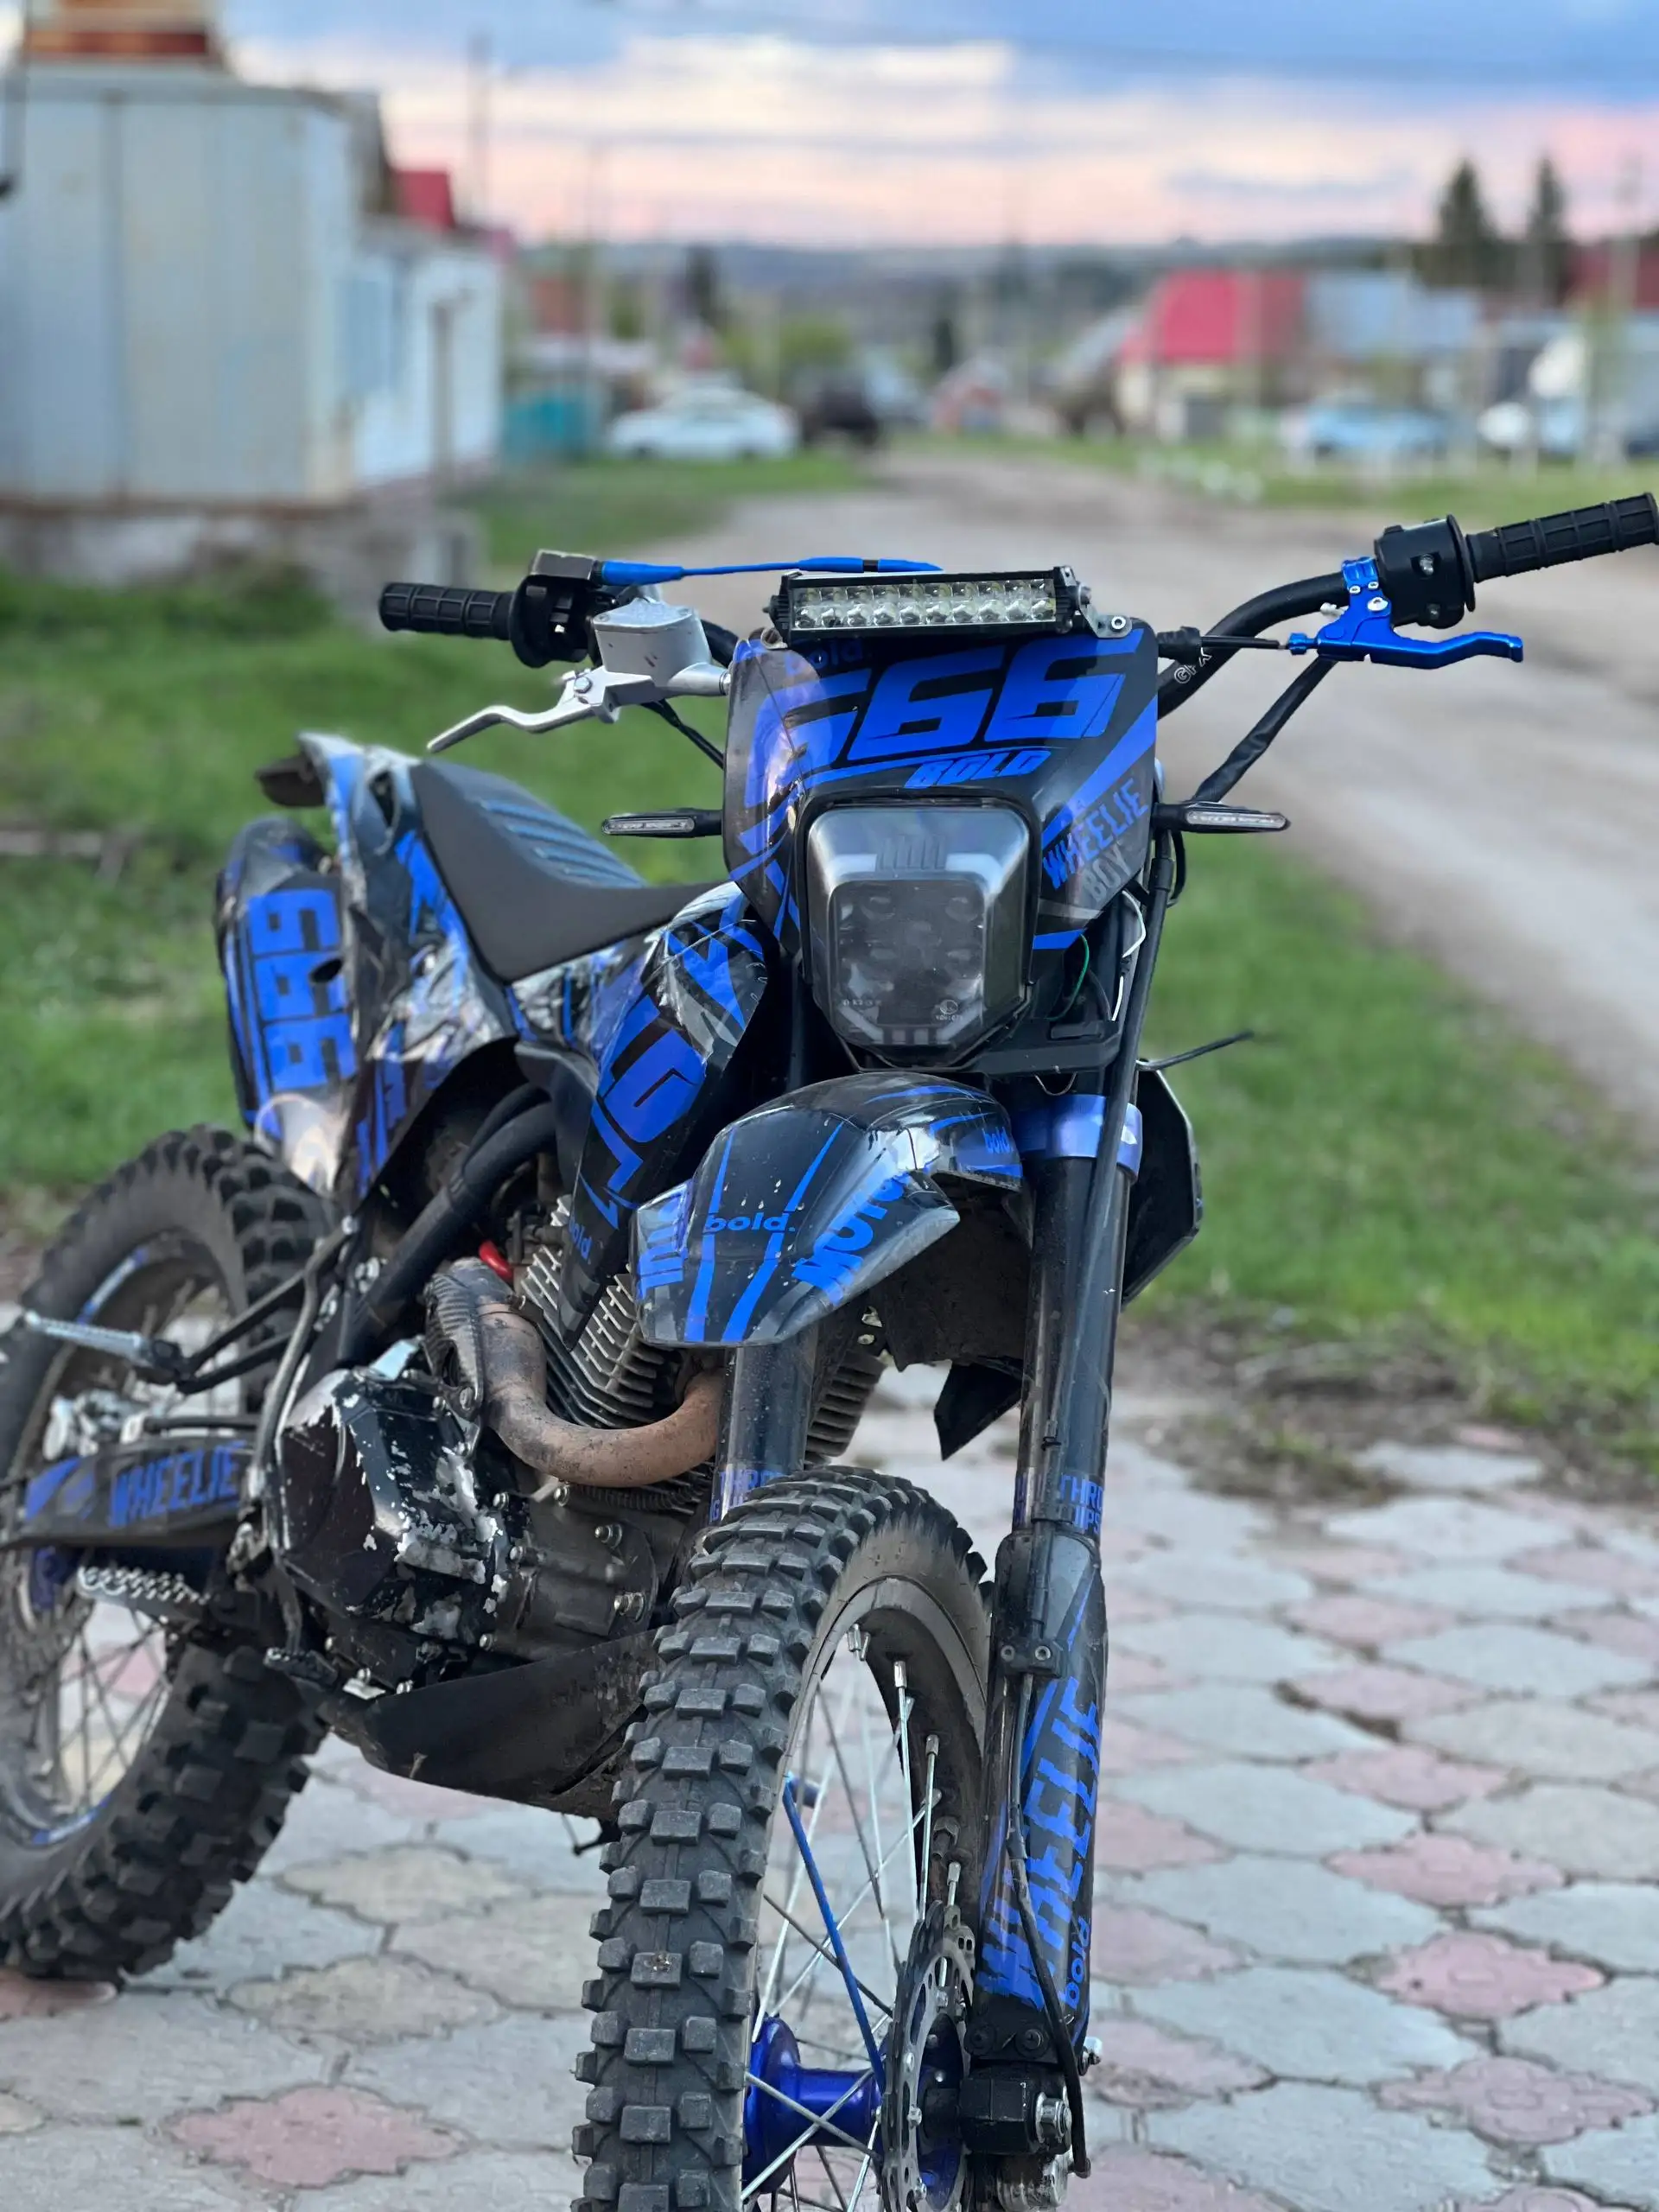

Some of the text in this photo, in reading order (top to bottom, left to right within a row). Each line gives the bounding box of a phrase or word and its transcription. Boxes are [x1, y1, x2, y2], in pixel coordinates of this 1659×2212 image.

[903, 749, 1052, 790] BOLD
[1042, 779, 1149, 891] WHEELIE
[1079, 842, 1132, 904] BOY
[110, 1440, 247, 1529] WHEELIE
